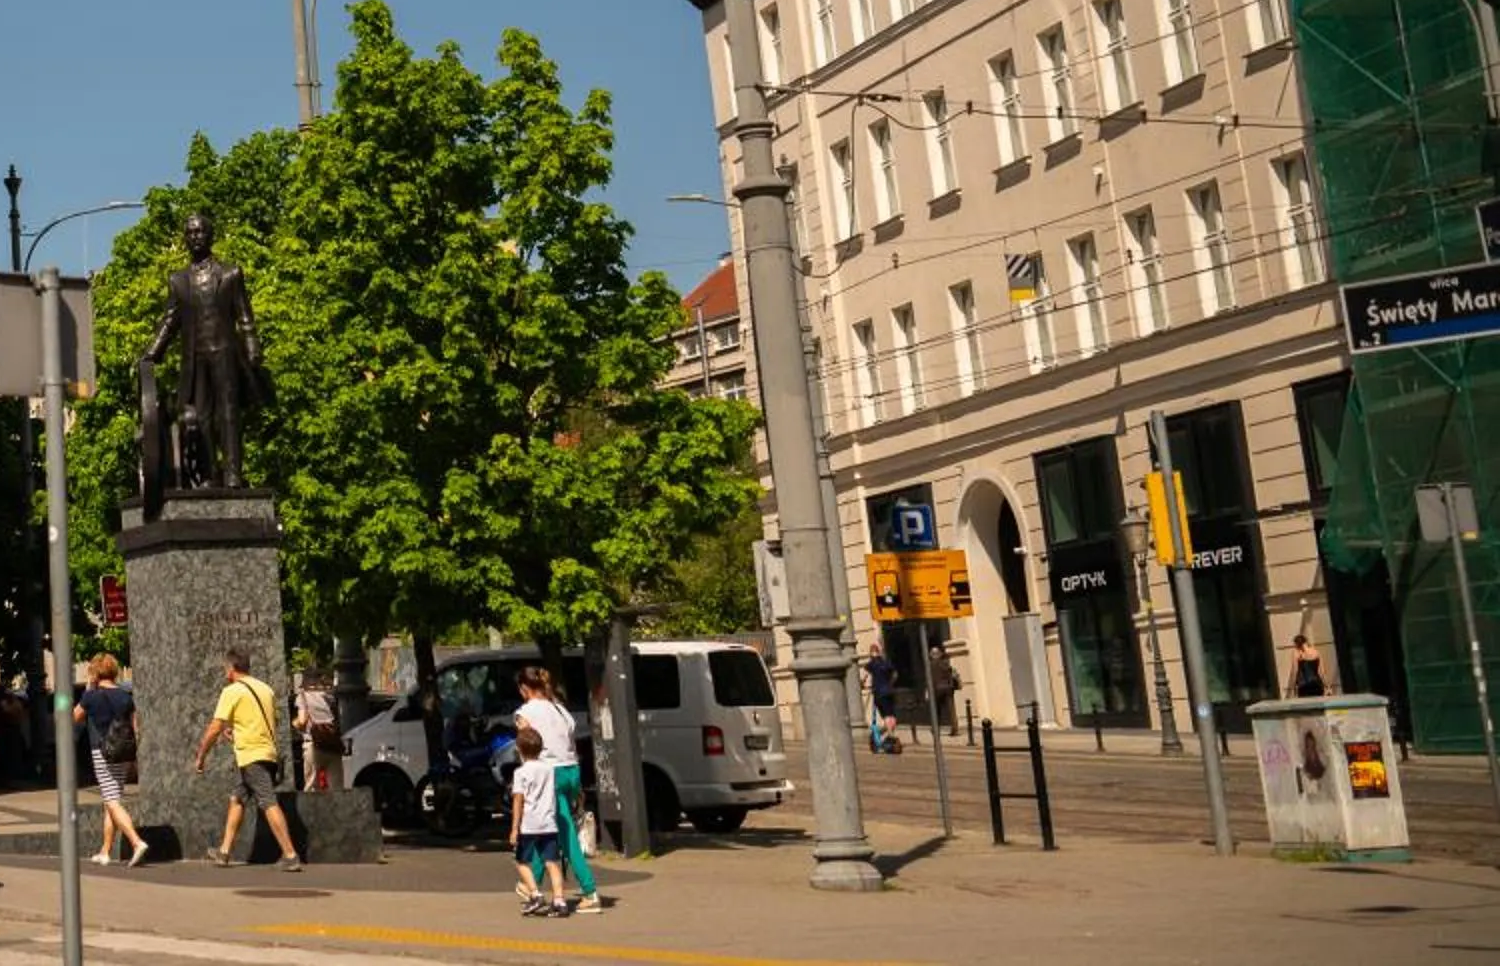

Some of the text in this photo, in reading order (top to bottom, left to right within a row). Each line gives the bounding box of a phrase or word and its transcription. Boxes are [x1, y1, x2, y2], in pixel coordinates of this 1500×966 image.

[1429, 277, 1459, 290] ulica
[1366, 290, 1500, 327] Święty Mar
[901, 510, 925, 546] P
[1190, 545, 1243, 569] REVER
[1061, 570, 1107, 592] OPTYK
